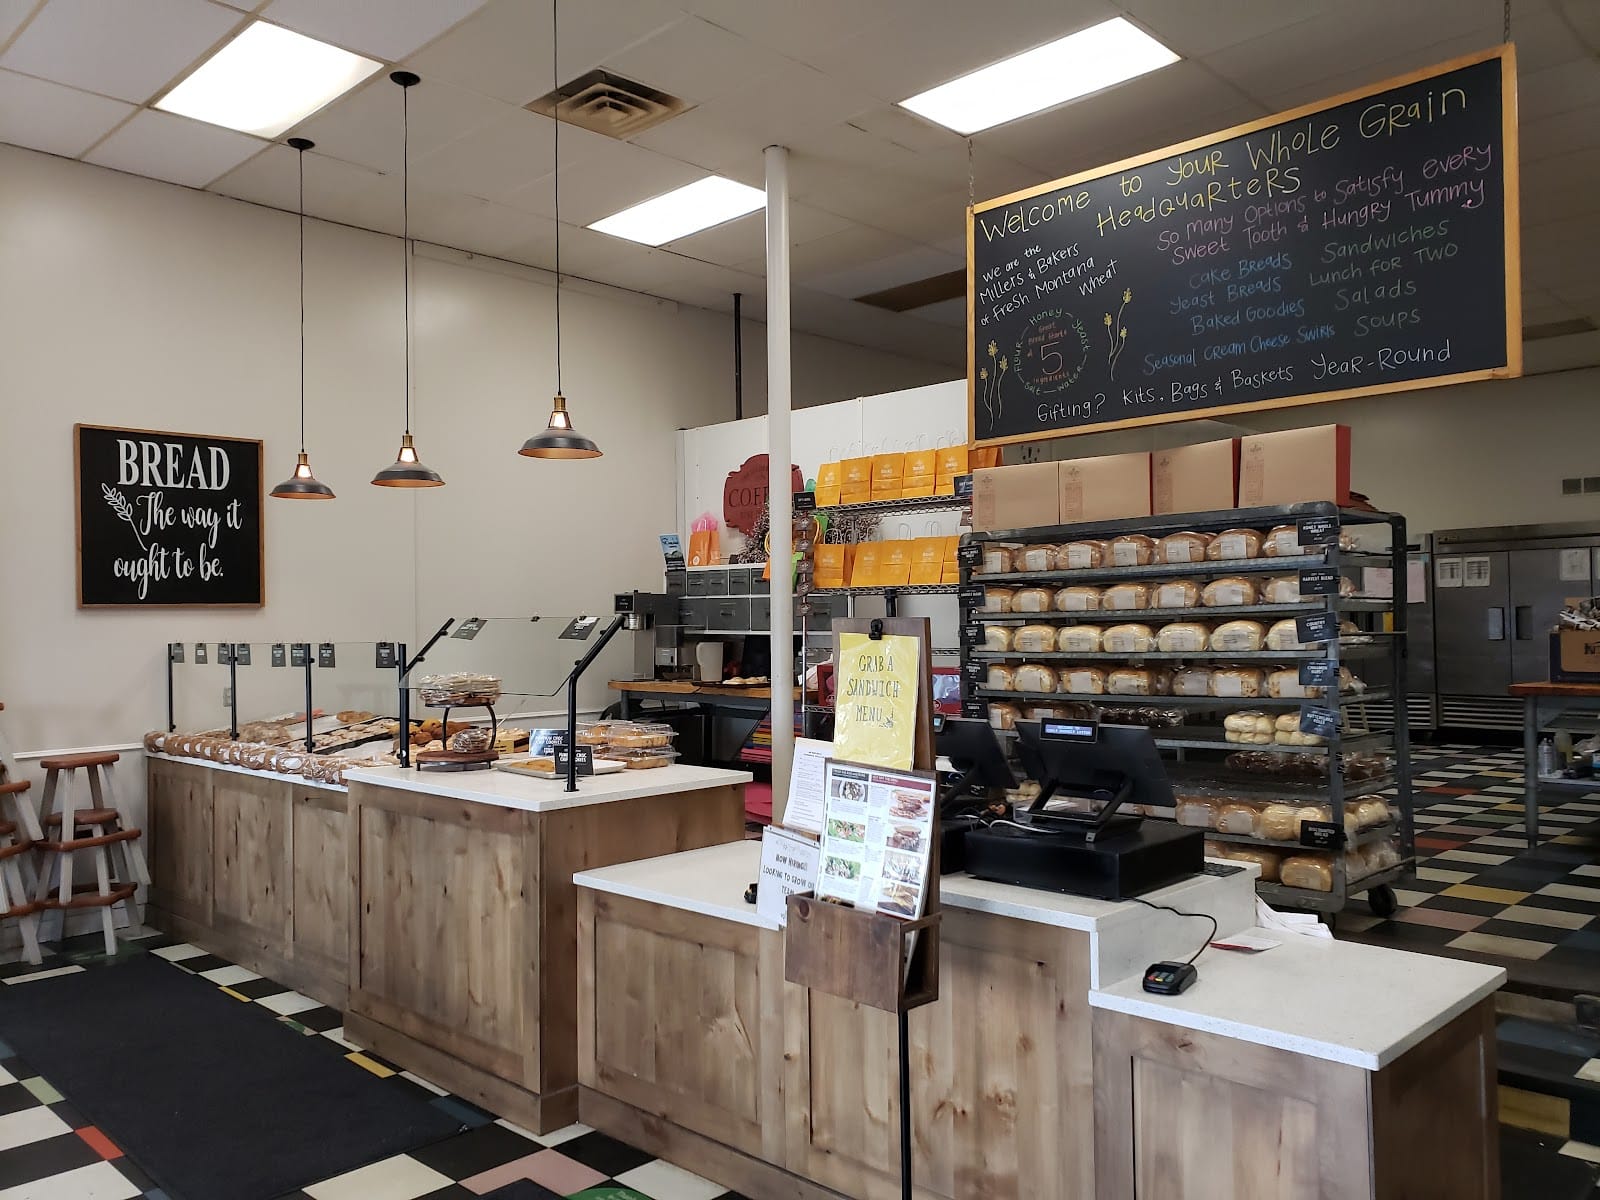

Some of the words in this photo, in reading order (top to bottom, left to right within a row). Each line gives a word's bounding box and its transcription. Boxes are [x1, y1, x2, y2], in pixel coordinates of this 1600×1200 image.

[980, 190, 1091, 242] Welcome
[1119, 175, 1142, 197] to
[1157, 230, 1180, 251] So
[1245, 196, 1307, 225] Options
[1314, 190, 1327, 202] to
[1333, 166, 1404, 204] Satisfy
[1242, 221, 1287, 249] Tooth
[1404, 179, 1485, 212] Tummy
[1005, 258, 1020, 272] are
[1024, 244, 1041, 258] the
[1321, 220, 1449, 263] Sandwiches
[979, 272, 1025, 305] Millers
[980, 315, 990, 326] of
[1035, 256, 1095, 299] Montana
[1079, 258, 1118, 296] Wheat
[1310, 263, 1362, 286] Lunch
[1246, 299, 1305, 322] Goodies
[1334, 279, 1417, 311] Salads
[1040, 341, 1063, 375] 5
[1143, 348, 1197, 376] Seasonal
[1250, 333, 1290, 352] Cheese
[1037, 393, 1106, 422] Gifting?
[1171, 382, 1208, 402] Bags
[1230, 366, 1294, 389] Baskets
[116, 439, 230, 491] BREAD
[136, 491, 176, 536] The
[181, 506, 221, 549] way
[226, 498, 242, 530] it
[113, 542, 171, 600] ought
[171, 546, 194, 579] to
[199, 542, 224, 581] be.
[859, 654, 884, 673] GRAB
[888, 655, 893, 672] A
[847, 678, 900, 698] SANDWICH
[856, 704, 883, 722] MENU
[763, 865, 783, 879] LOOKING
[784, 872, 790, 881] TO
[791, 875, 807, 887] GROW
[775, 853, 788, 864] NOW
